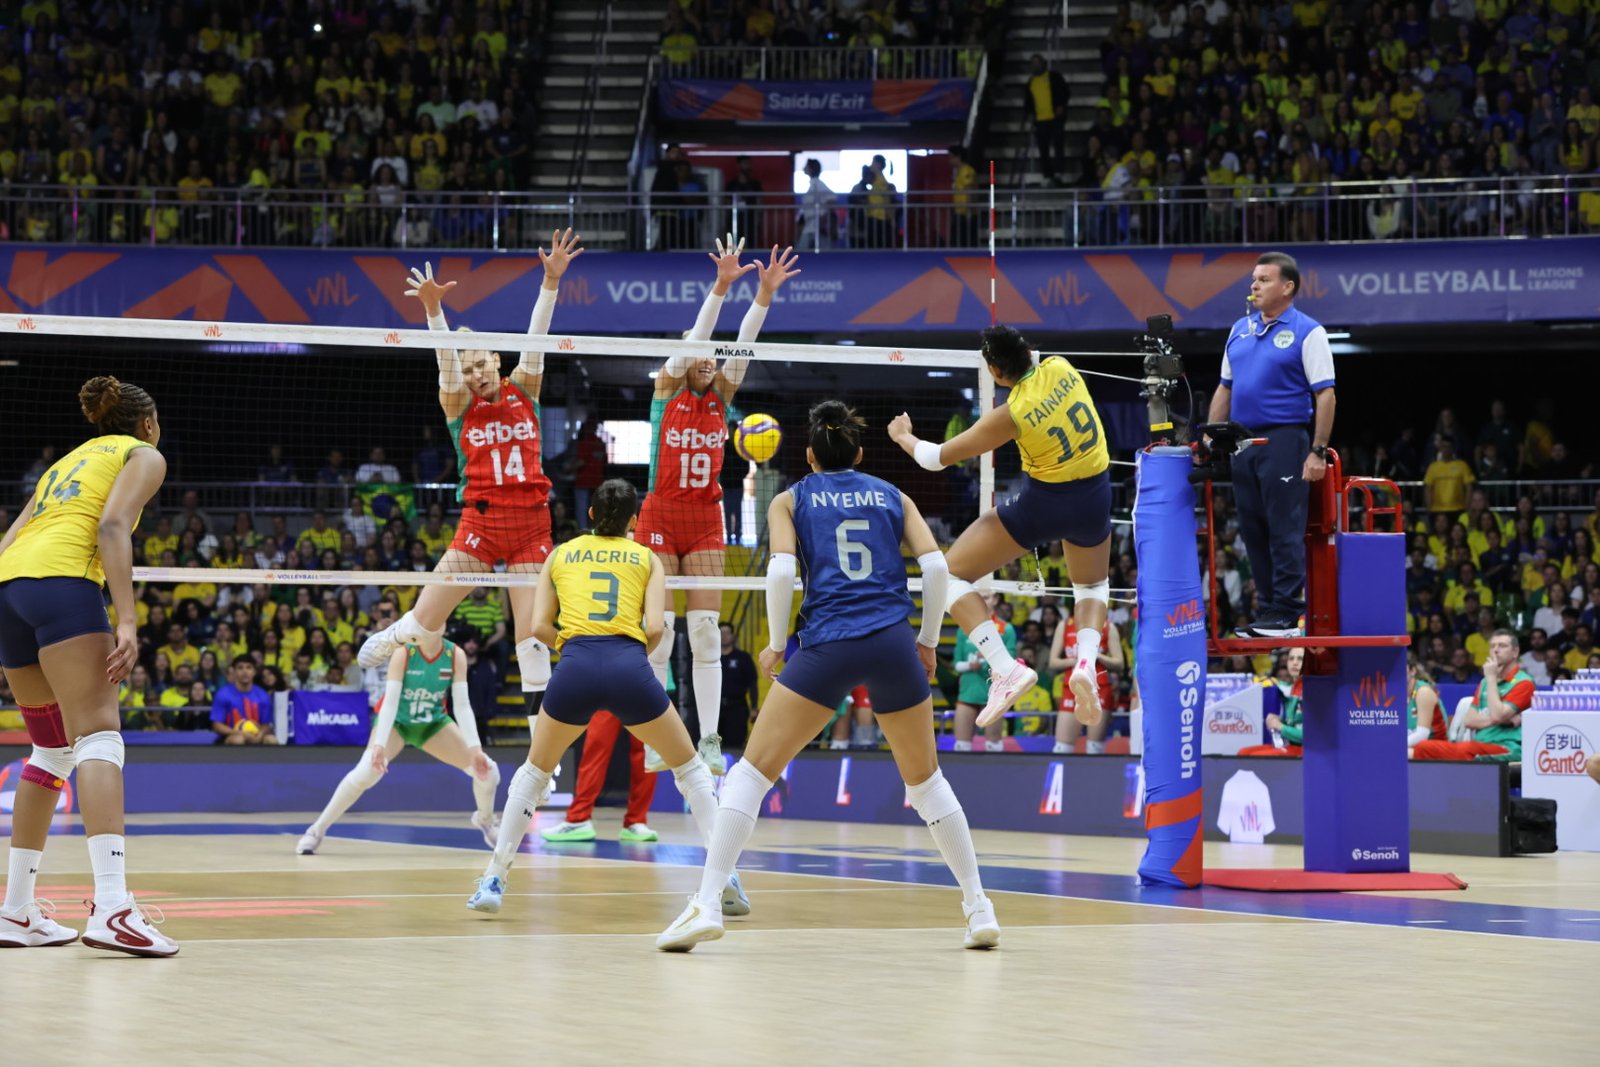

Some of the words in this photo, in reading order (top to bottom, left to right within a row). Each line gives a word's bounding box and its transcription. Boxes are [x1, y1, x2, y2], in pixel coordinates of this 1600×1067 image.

[1528, 267, 1584, 278] NATIONS
[790, 281, 843, 291] NATIONS
[1338, 269, 1523, 296] VOLLEYBALL
[1528, 279, 1577, 291] LEAGUE
[790, 292, 837, 303] LEAGUE
[17, 317, 36, 331] VNL
[204, 324, 223, 338] VNL
[384, 331, 402, 345] VNL
[558, 337, 576, 351] VNL
[1023, 371, 1080, 428] TAINARA
[466, 418, 536, 447] efbet
[665, 427, 725, 449] efbet
[1046, 401, 1098, 464] 19
[490, 445, 526, 485] 14
[679, 453, 711, 488] 19
[32, 459, 88, 518] 14
[811, 490, 887, 508] NYEME
[464, 532, 481, 549] 14
[564, 549, 641, 566] MACRIS
[835, 518, 873, 581] 6
[588, 571, 620, 622] 3
[410, 701, 435, 723] 15
[1349, 710, 1399, 718] VOLLEYBALL
[1180, 687, 1198, 779] Senoh
[1545, 733, 1582, 750] 百岁山
[1363, 850, 1399, 860] Senoh
